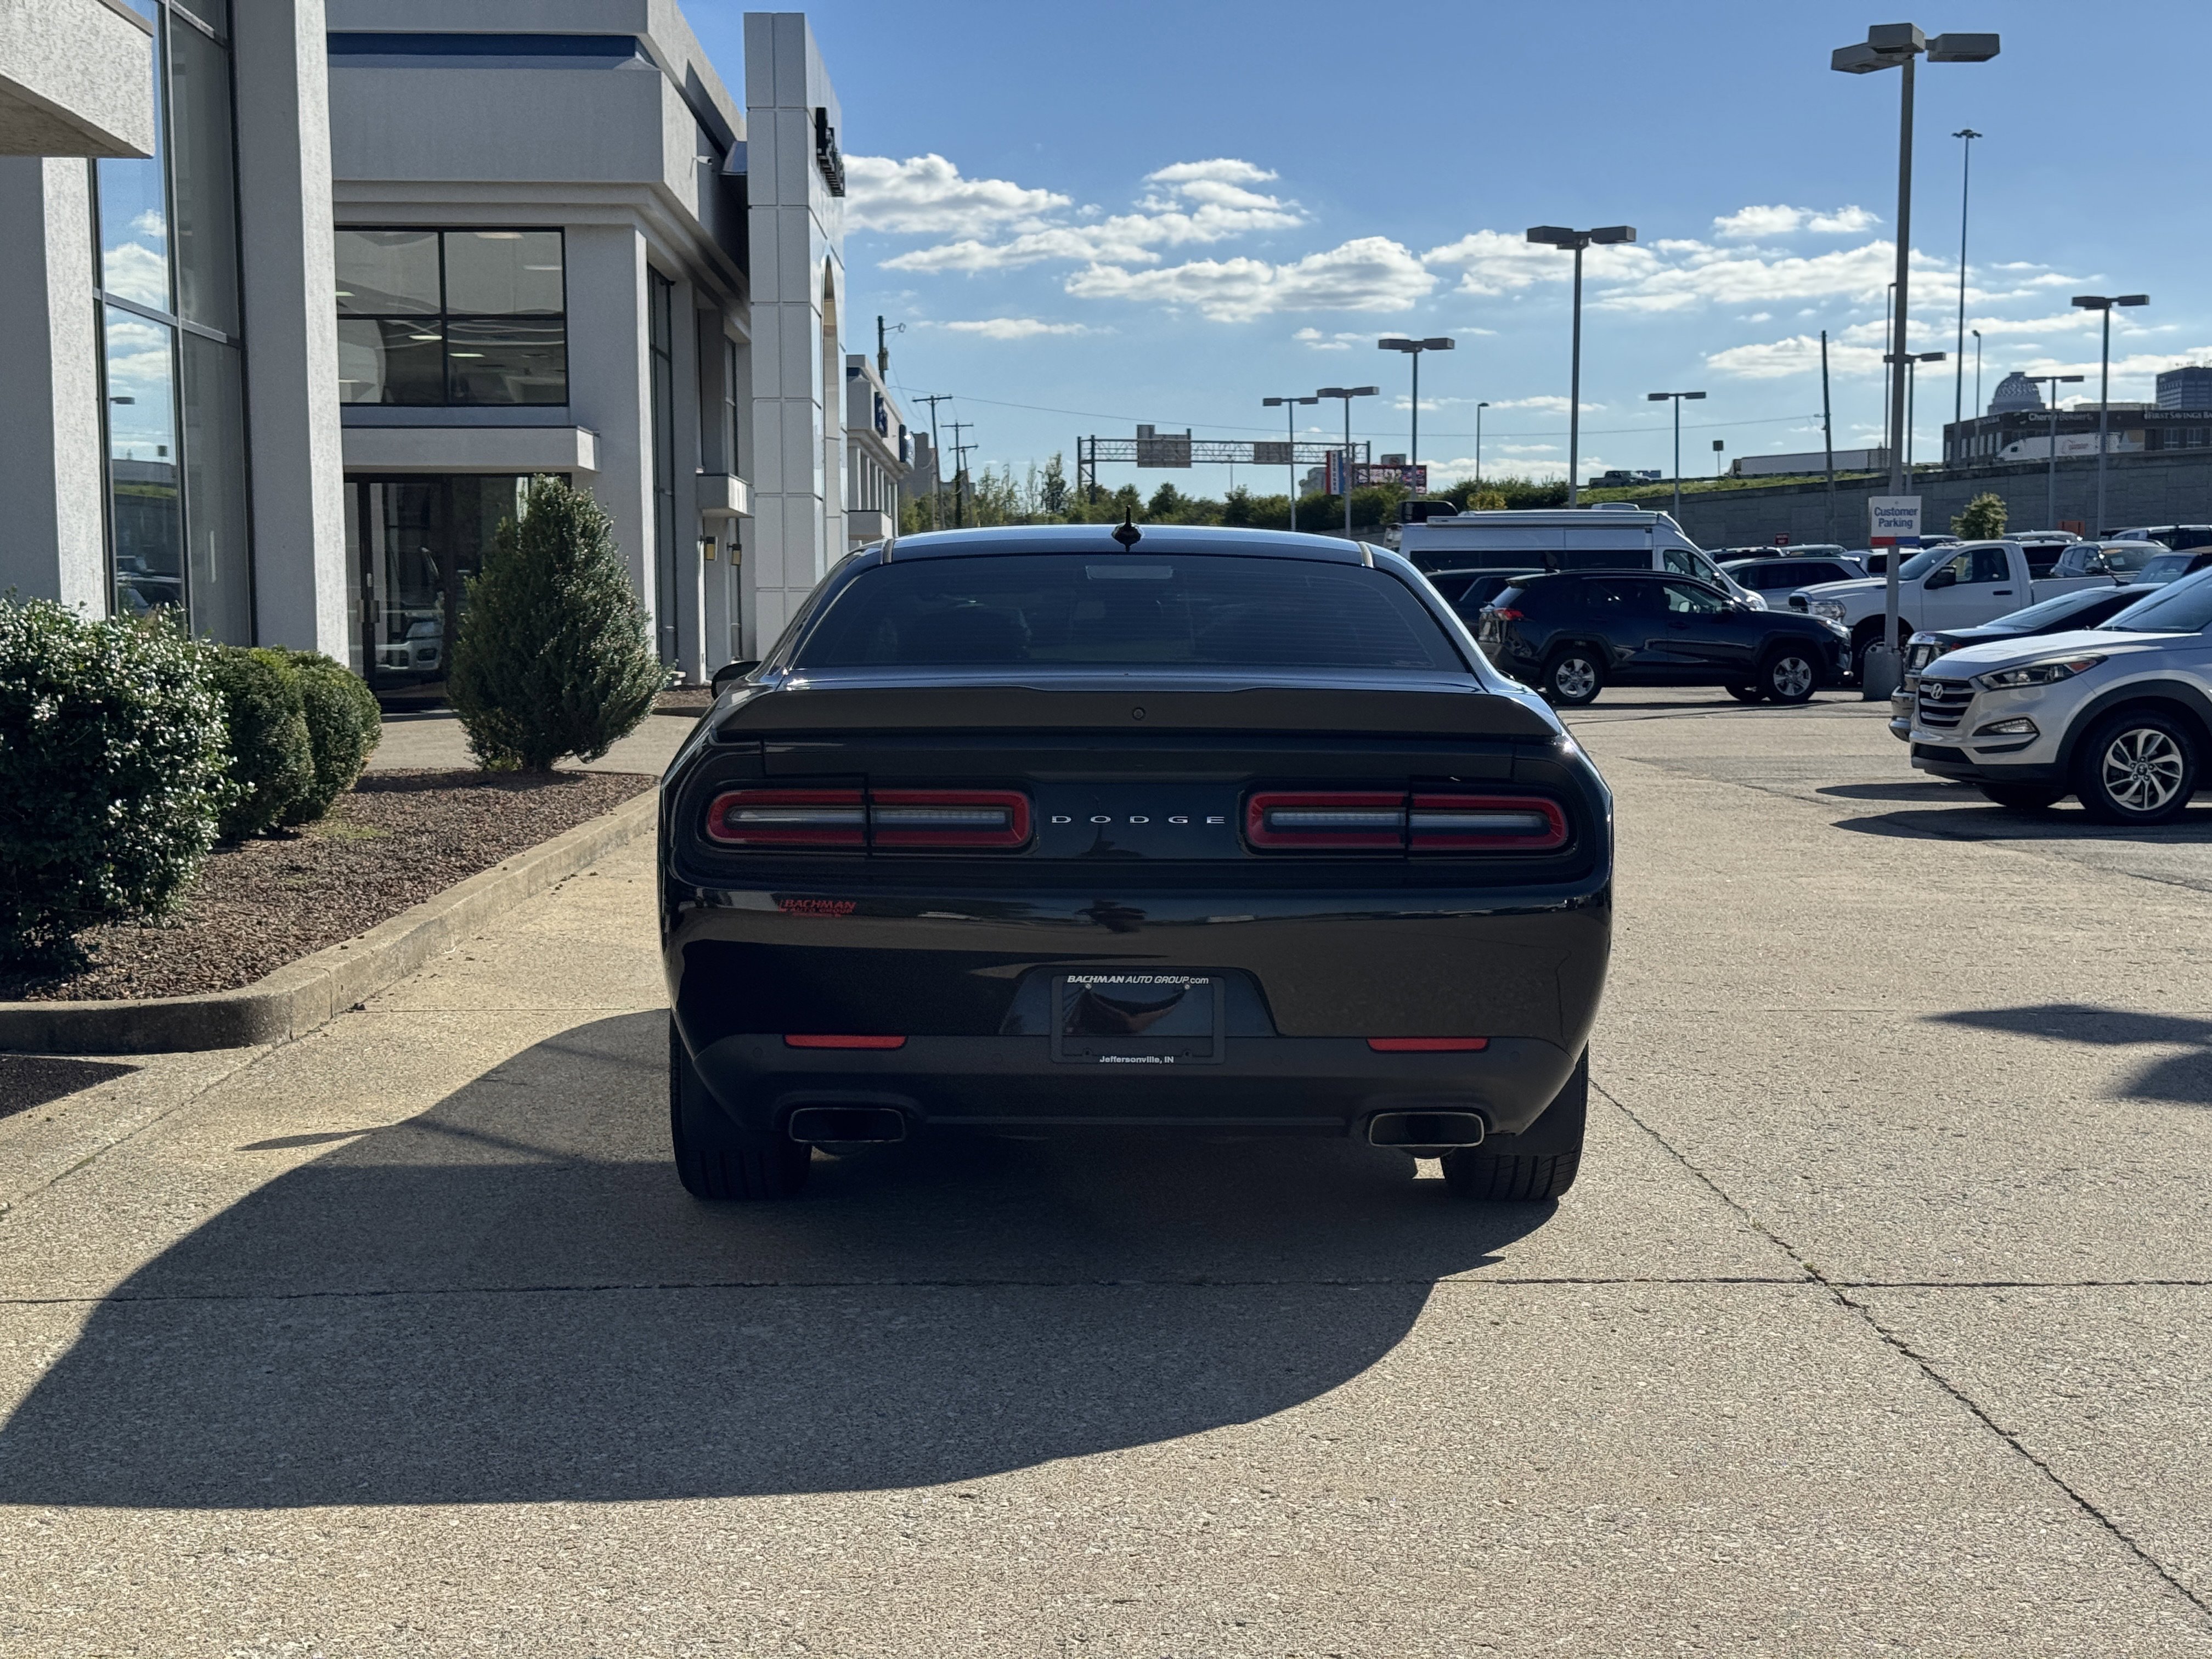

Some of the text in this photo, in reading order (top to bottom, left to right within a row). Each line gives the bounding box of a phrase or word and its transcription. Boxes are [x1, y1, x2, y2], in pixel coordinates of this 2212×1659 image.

[1874, 507, 1918, 516] Customer
[1878, 518, 1913, 529] Parking
[1052, 816, 1225, 824] DODGE
[785, 899, 856, 909] BACHMAN
[1099, 1056, 1163, 1064] Jeffersonville,
